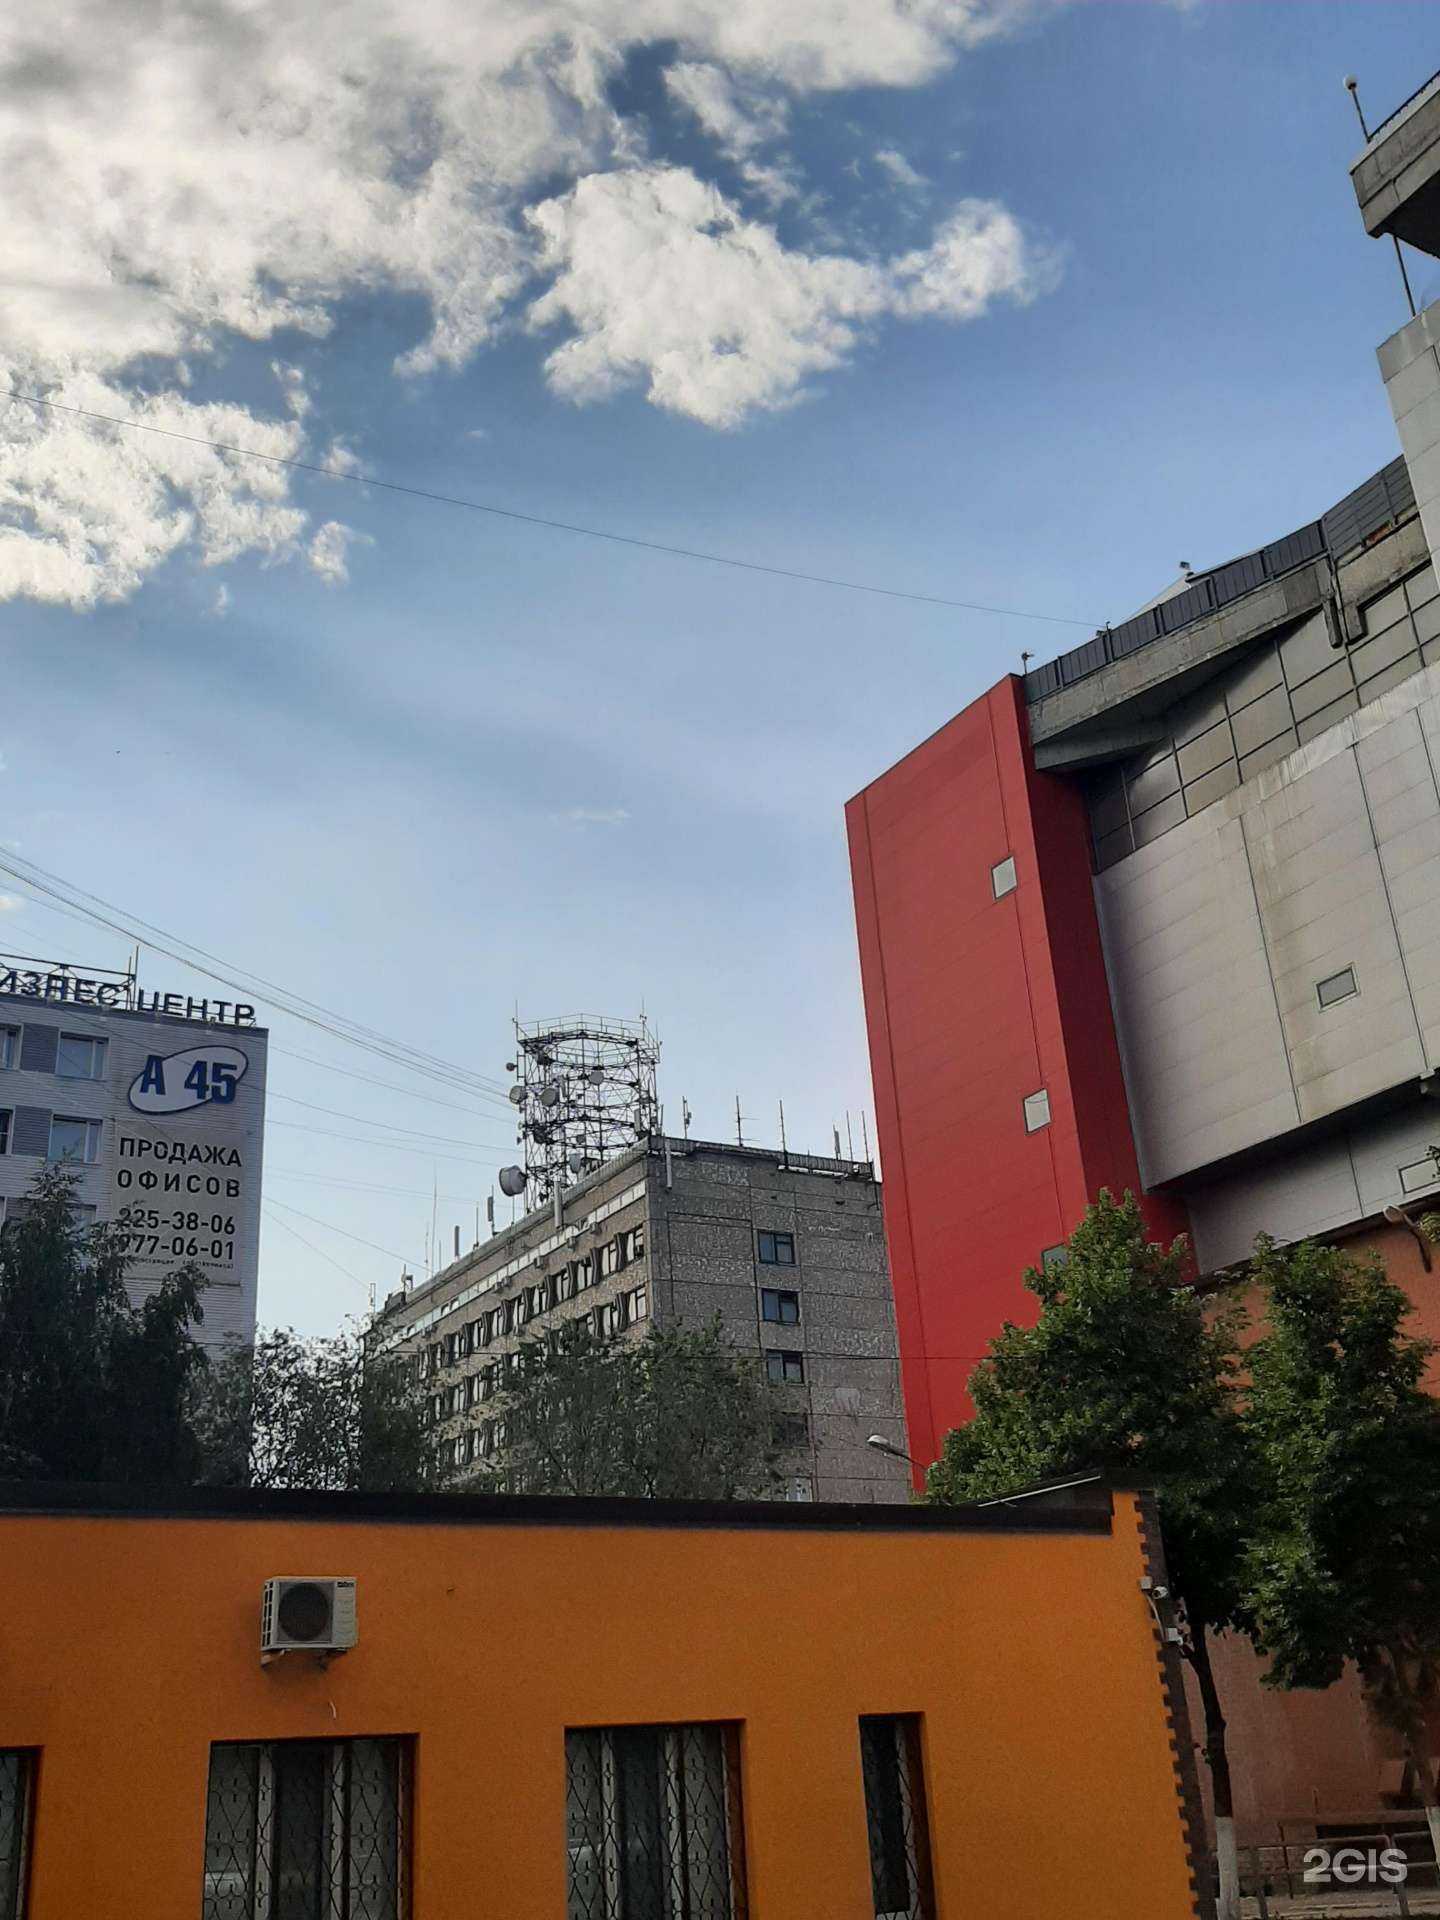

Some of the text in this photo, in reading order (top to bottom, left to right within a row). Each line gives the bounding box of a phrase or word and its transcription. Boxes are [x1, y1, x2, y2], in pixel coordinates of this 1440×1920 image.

[137, 988, 255, 1026] ЦЕНТР
[184, 1061, 238, 1104] 45
[119, 1136, 242, 1167] ПРОДАЖА
[117, 1169, 240, 1198] ОФИСОВ
[119, 1207, 235, 1235] 225-38-06
